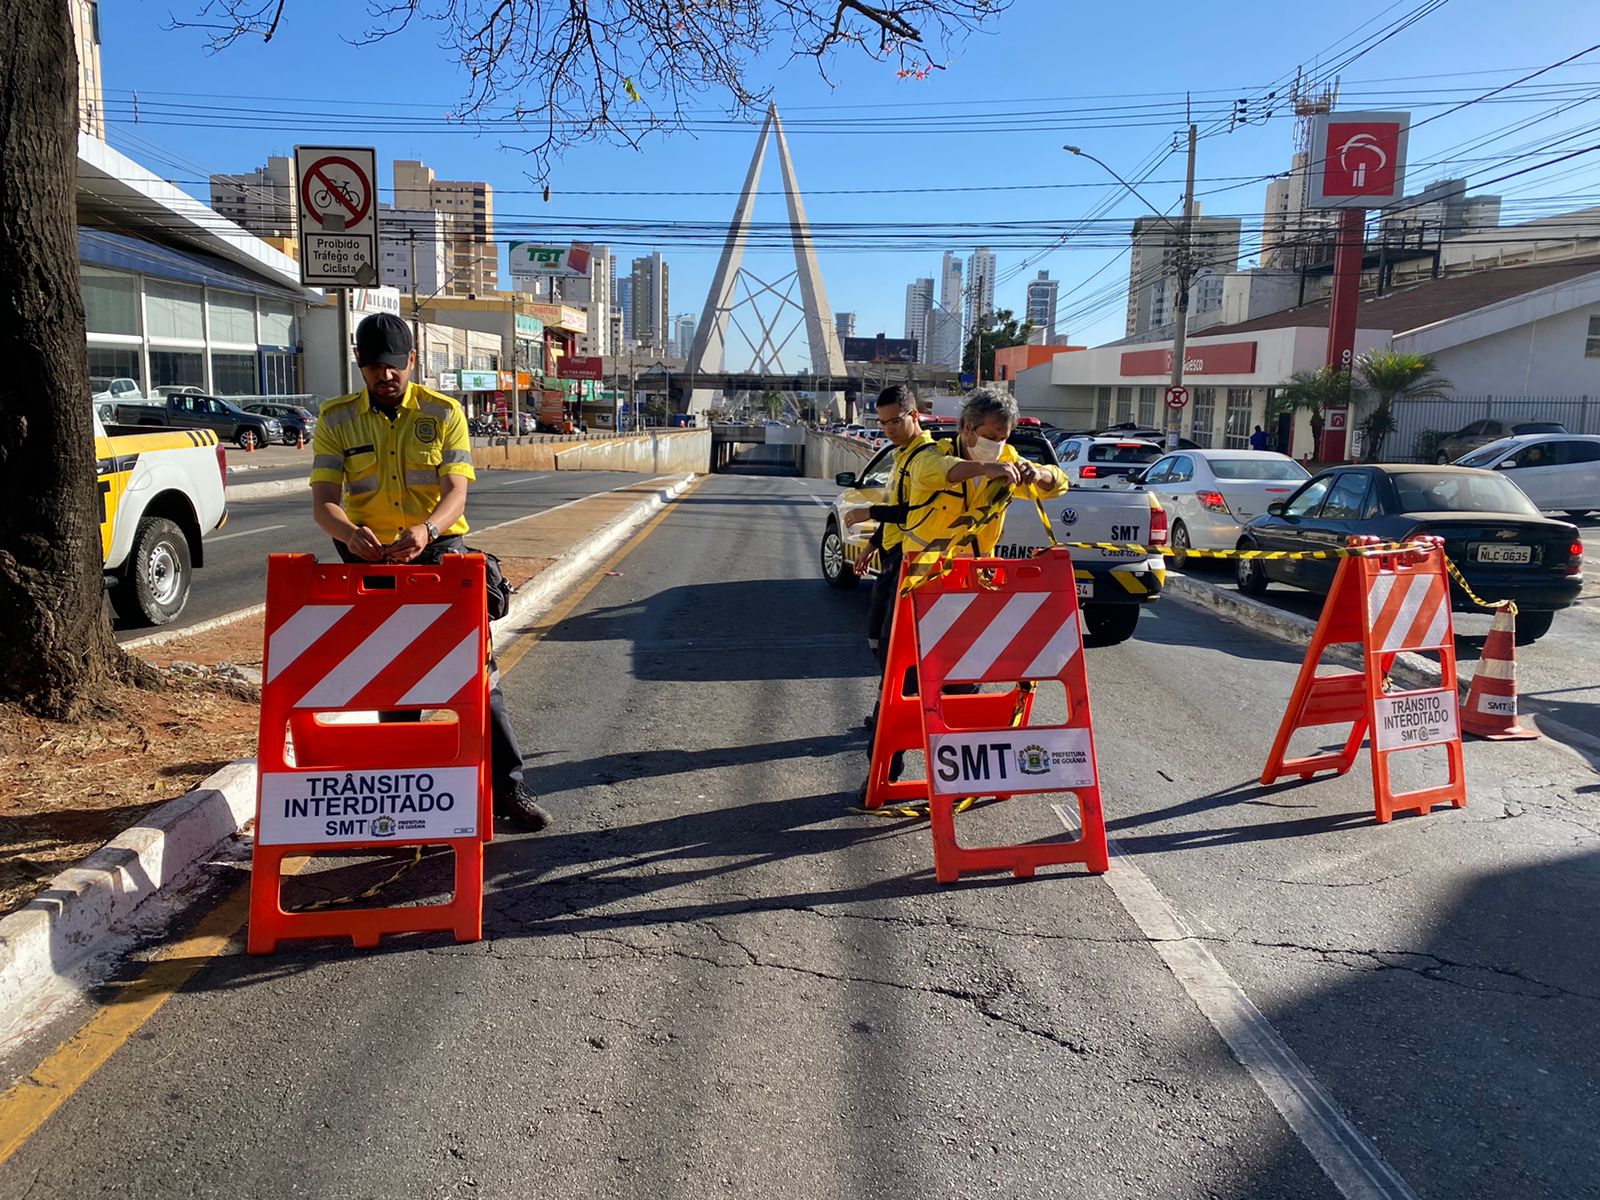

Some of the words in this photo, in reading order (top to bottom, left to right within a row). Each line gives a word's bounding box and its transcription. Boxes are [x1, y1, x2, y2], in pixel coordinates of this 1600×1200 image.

[317, 239, 360, 249] Proibido
[313, 250, 349, 263] Tráfego
[353, 252, 365, 261] de
[322, 263, 357, 273] Ciclista
[367, 294, 398, 310] MILANO
[1111, 525, 1140, 541] SMT
[1391, 697, 1440, 714] TRÂNSITO
[1488, 701, 1507, 711] SMT
[1384, 709, 1449, 730] INTERDITADO
[1401, 729, 1418, 742] SMT
[937, 743, 1012, 782] SMT
[306, 773, 434, 797] TRÂNSITO
[284, 792, 454, 818] INTERDITADO
[325, 820, 368, 836] SMT
